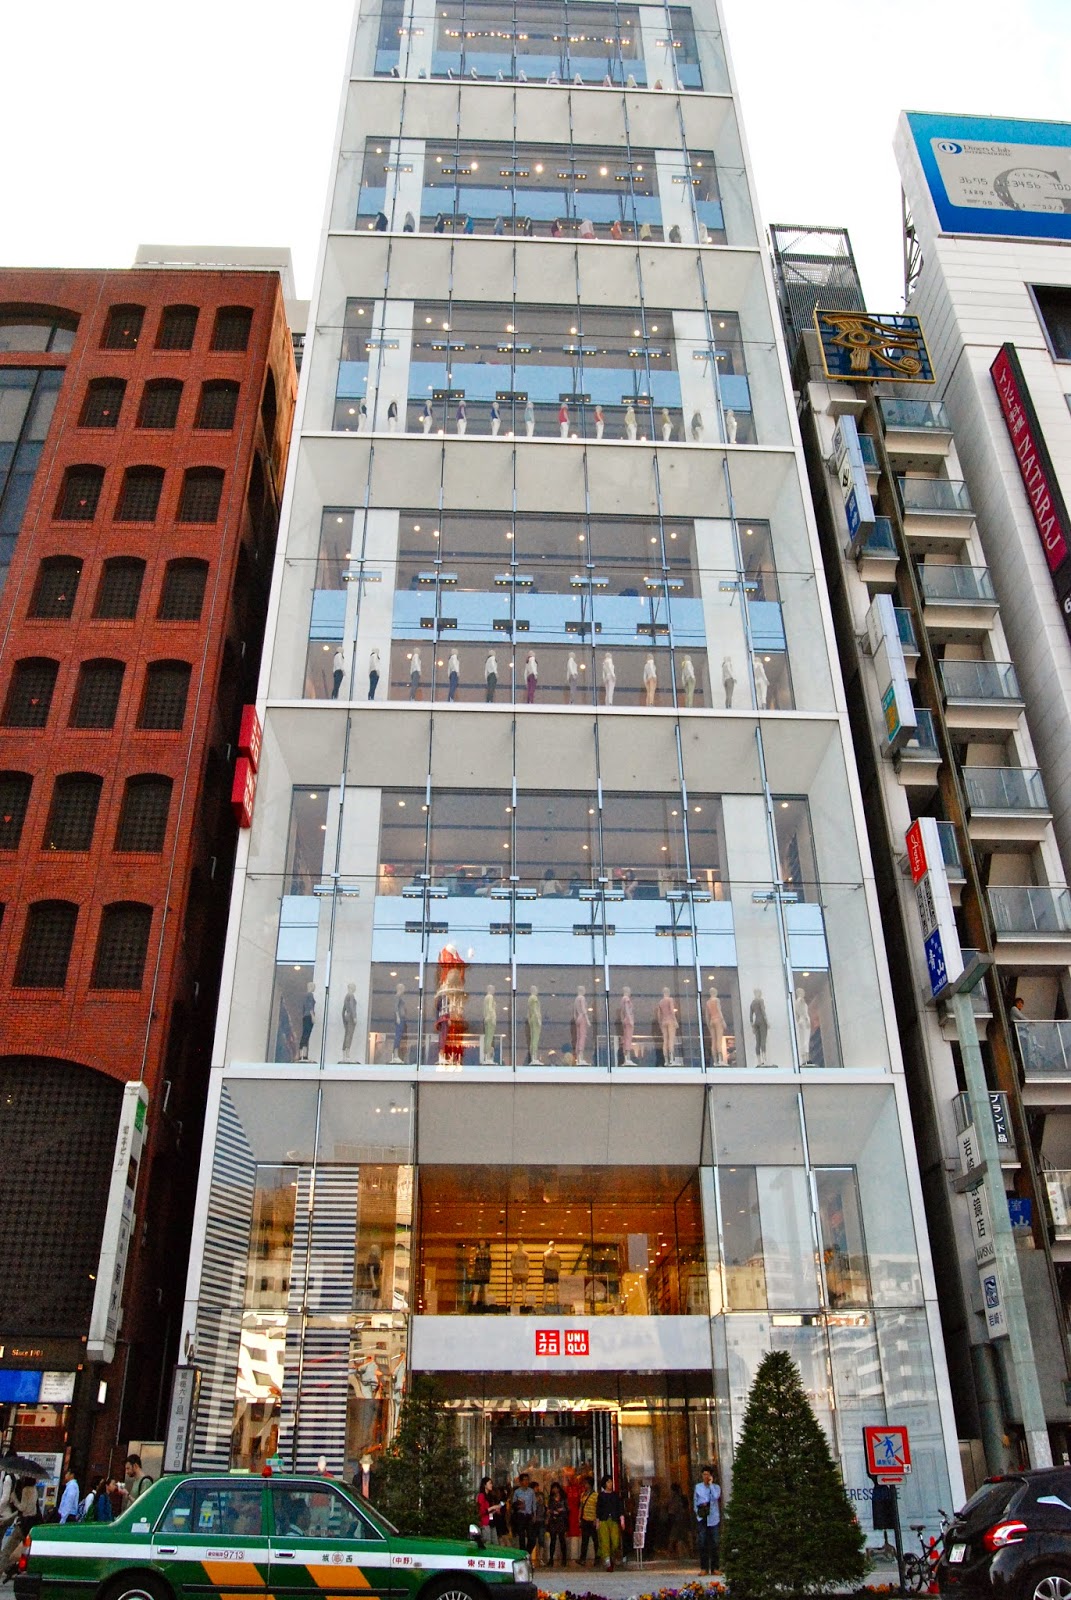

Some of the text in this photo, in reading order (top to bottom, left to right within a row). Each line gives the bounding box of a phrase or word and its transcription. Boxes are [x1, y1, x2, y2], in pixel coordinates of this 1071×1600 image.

[1017, 433, 1061, 552] NATARAJ
[990, 1093, 1008, 1143] ブランド品
[223, 1550, 244, 1559] 9713
